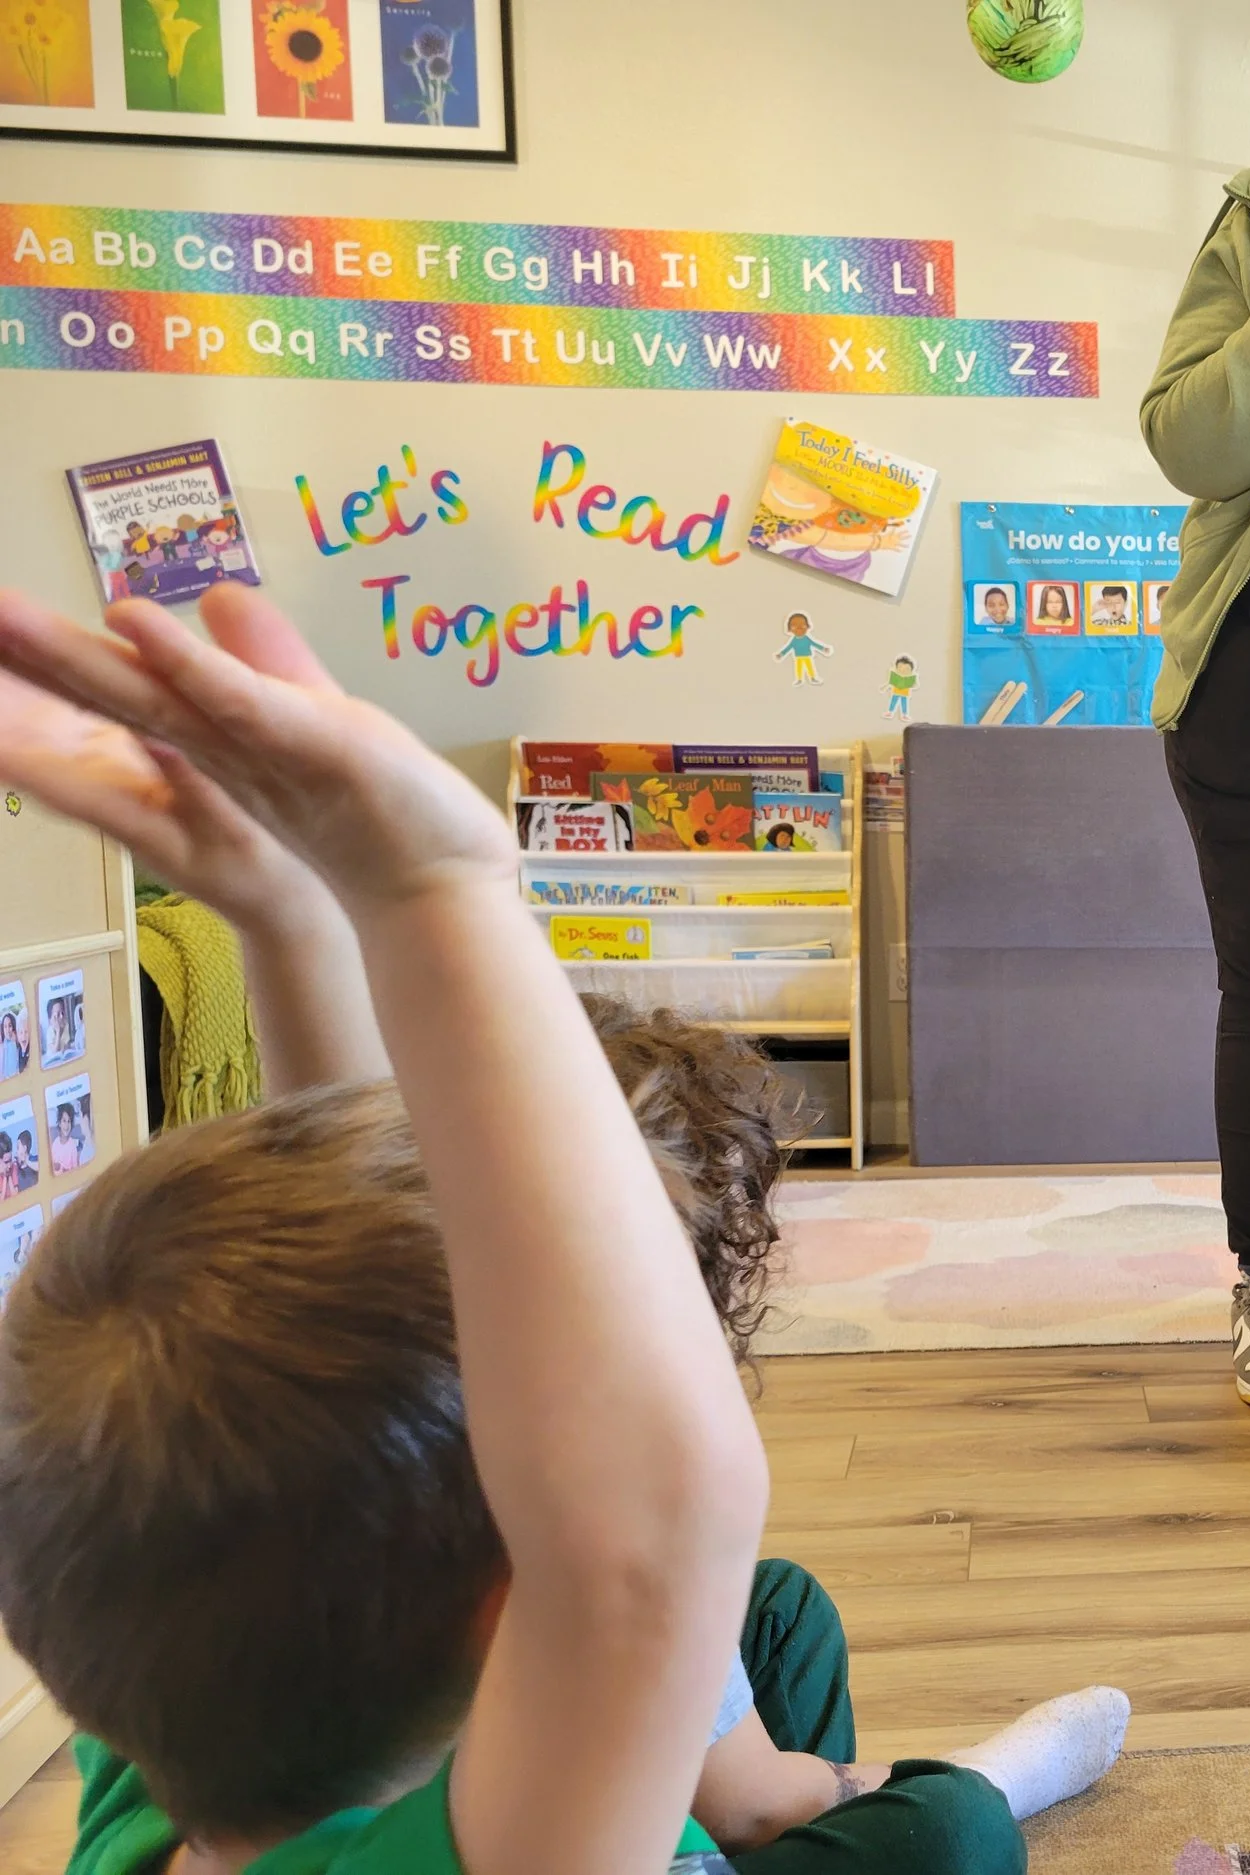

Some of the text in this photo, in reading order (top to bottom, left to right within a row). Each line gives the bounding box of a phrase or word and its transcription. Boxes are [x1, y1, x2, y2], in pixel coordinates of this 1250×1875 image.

[14, 228, 934, 299] Aa Bb Cc Dd Ee Ff Gg Hh Ii Jj Kk Ll
[60, 311, 135, 349] Oo
[164, 316, 225, 361] Pp
[248, 319, 315, 364] Qq
[339, 323, 393, 358] Rr
[415, 325, 472, 361] Ss
[492, 328, 539, 363] Tt
[556, 330, 615, 365] Uu
[633, 332, 687, 367] Vv
[703, 334, 781, 369] Ww
[828, 338, 887, 373] Xx
[919, 340, 977, 382] Yy
[1009, 343, 1070, 376] Zz
[797, 431, 840, 457] Today
[842, 447, 852, 462] I
[852, 451, 881, 474] Feel
[885, 463, 920, 490] Silly
[150, 491, 217, 513] SCHOOLS
[295, 440, 740, 566] Let's Read
[1008, 530, 1064, 551] How
[1068, 531, 1100, 551] do
[1105, 533, 1151, 557] you
[361, 575, 705, 687] Together
[539, 774, 572, 789] Red
[667, 777, 699, 792] Leaf
[711, 778, 742, 792] Man
[555, 838, 608, 851] BOX
[568, 928, 586, 941] Dr.
[588, 926, 618, 942] Seuss
[603, 952, 619, 960] One
